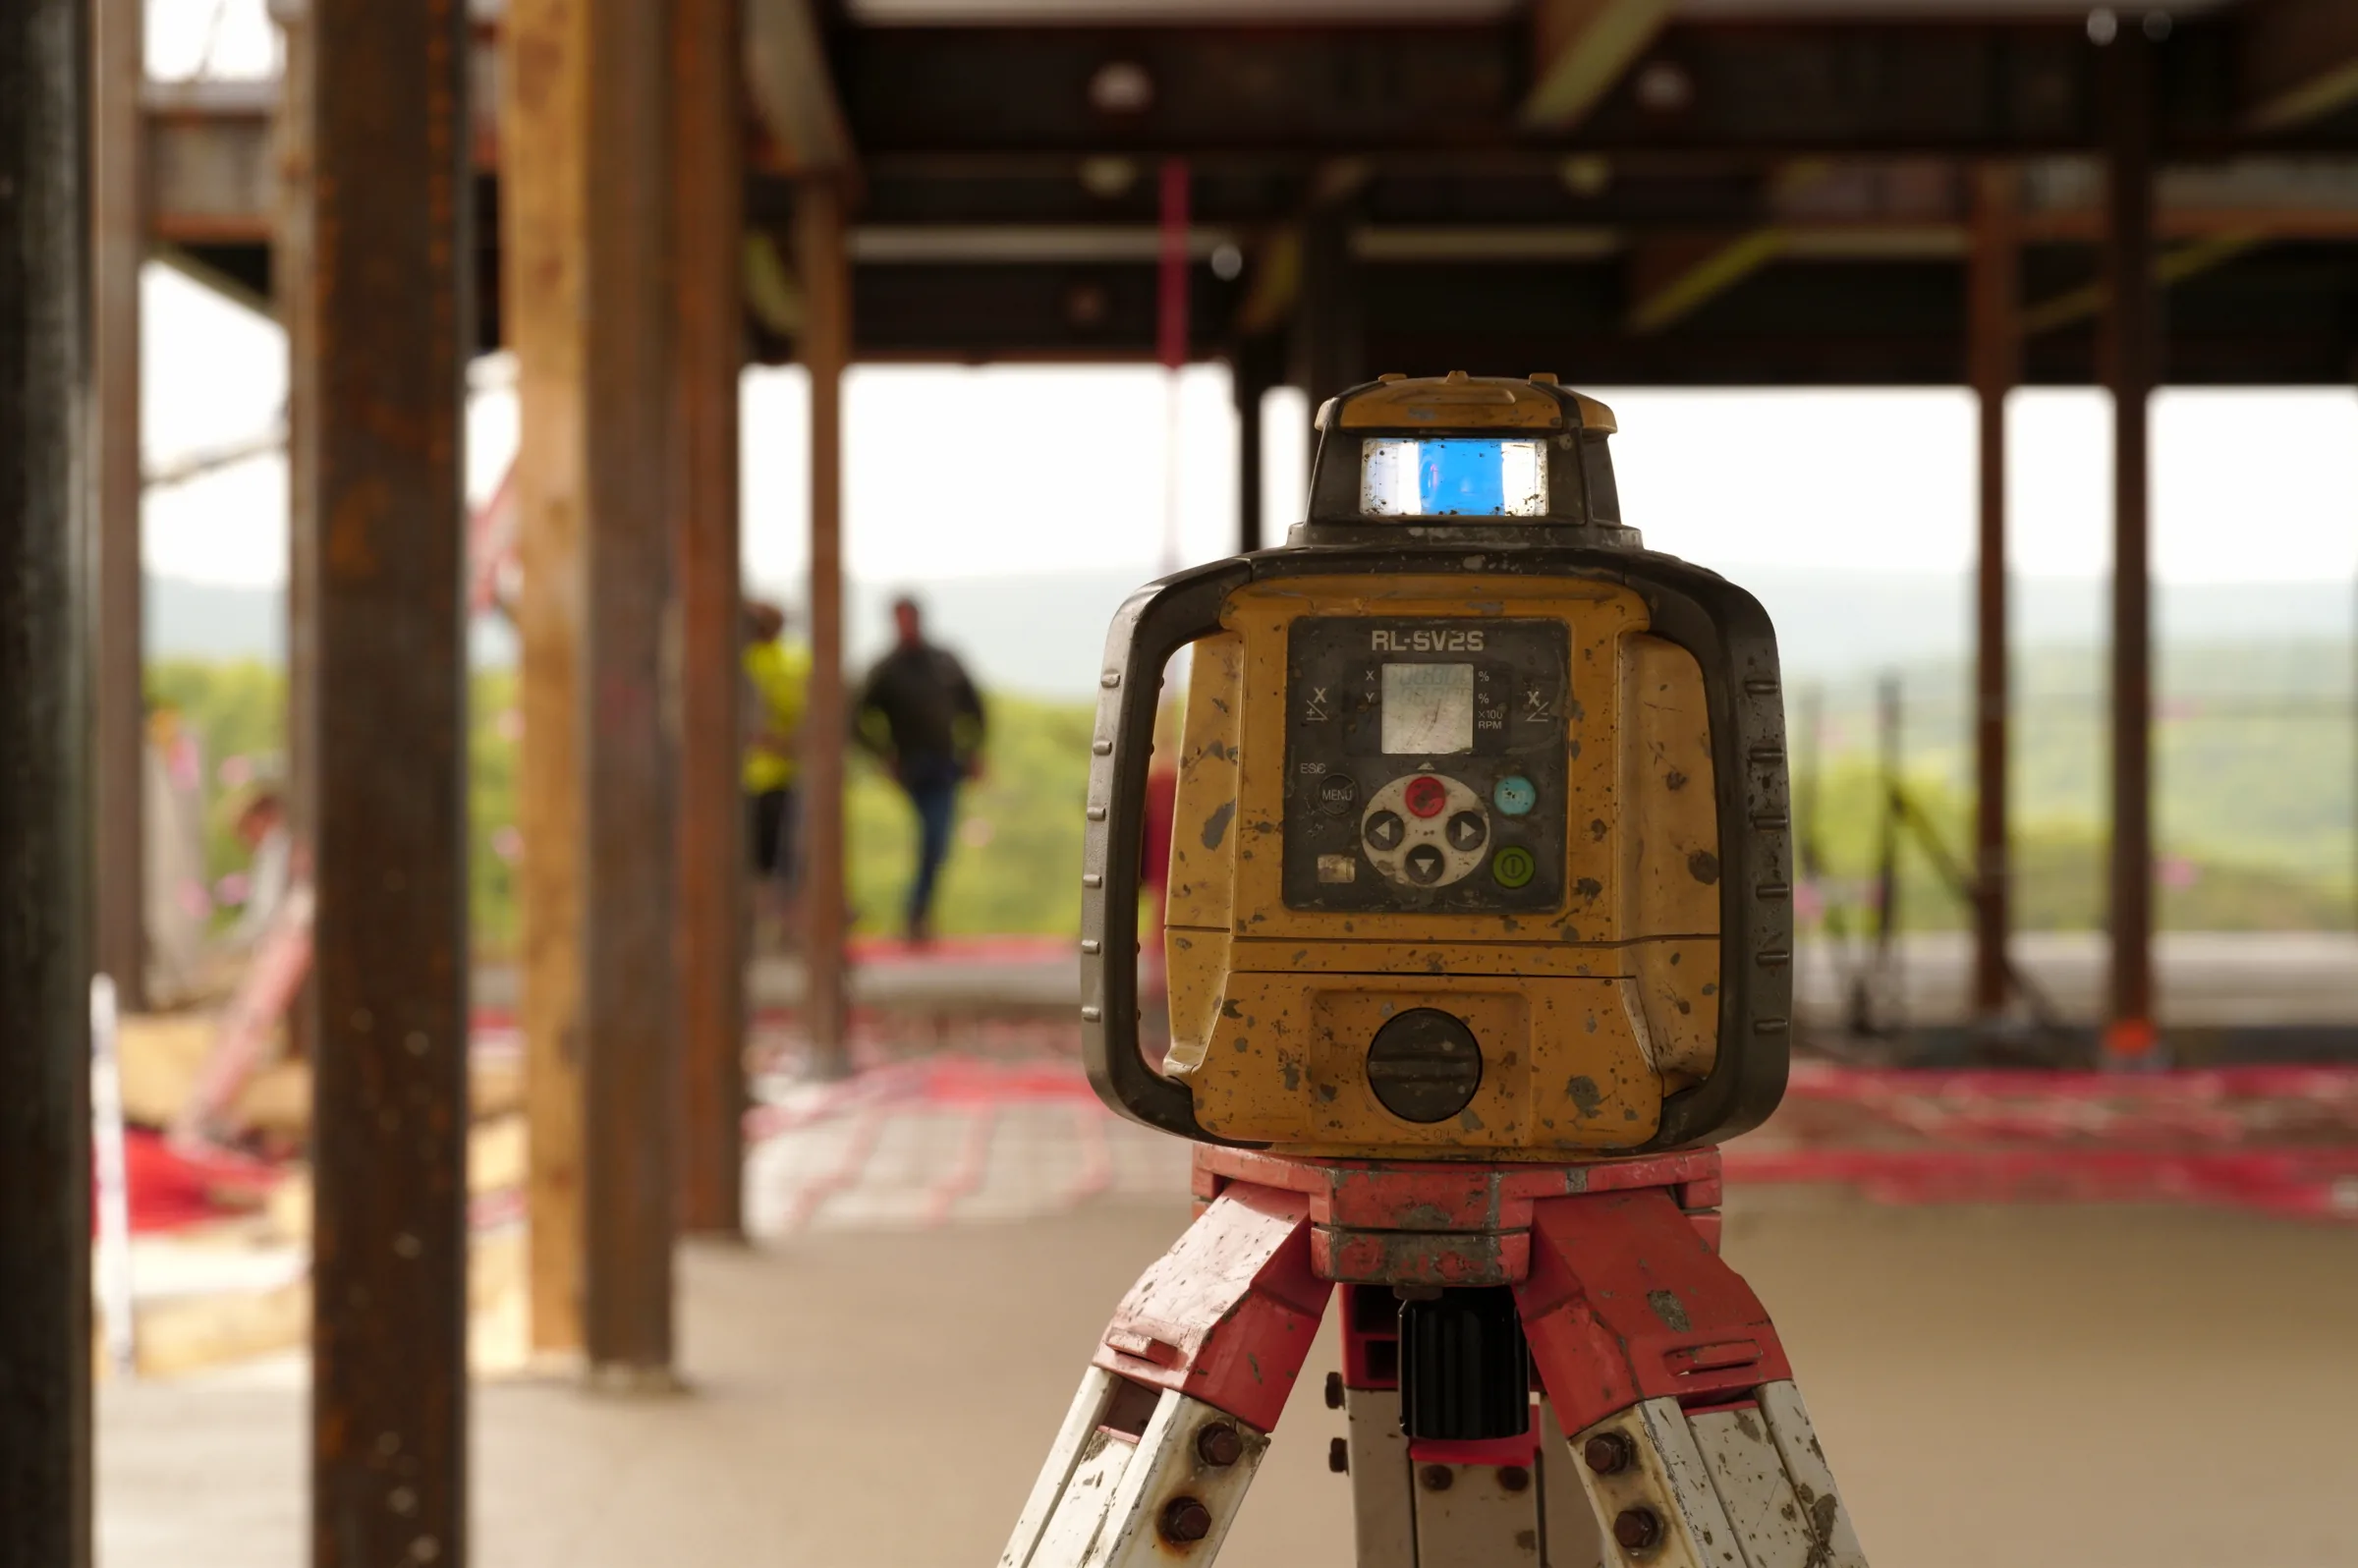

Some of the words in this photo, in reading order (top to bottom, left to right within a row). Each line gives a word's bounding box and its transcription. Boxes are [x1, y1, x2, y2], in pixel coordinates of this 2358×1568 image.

[1372, 630, 1485, 651] RL-SV2S
[1366, 670, 1375, 681] X
[1478, 670, 1489, 682] %
[1313, 687, 1327, 703] X
[1366, 693, 1375, 702] Y
[1478, 693, 1489, 703] %
[1527, 691, 1541, 706] X
[1478, 720, 1502, 729] RPM
[1300, 762, 1326, 774] ESC
[1321, 789, 1353, 801] MENU
